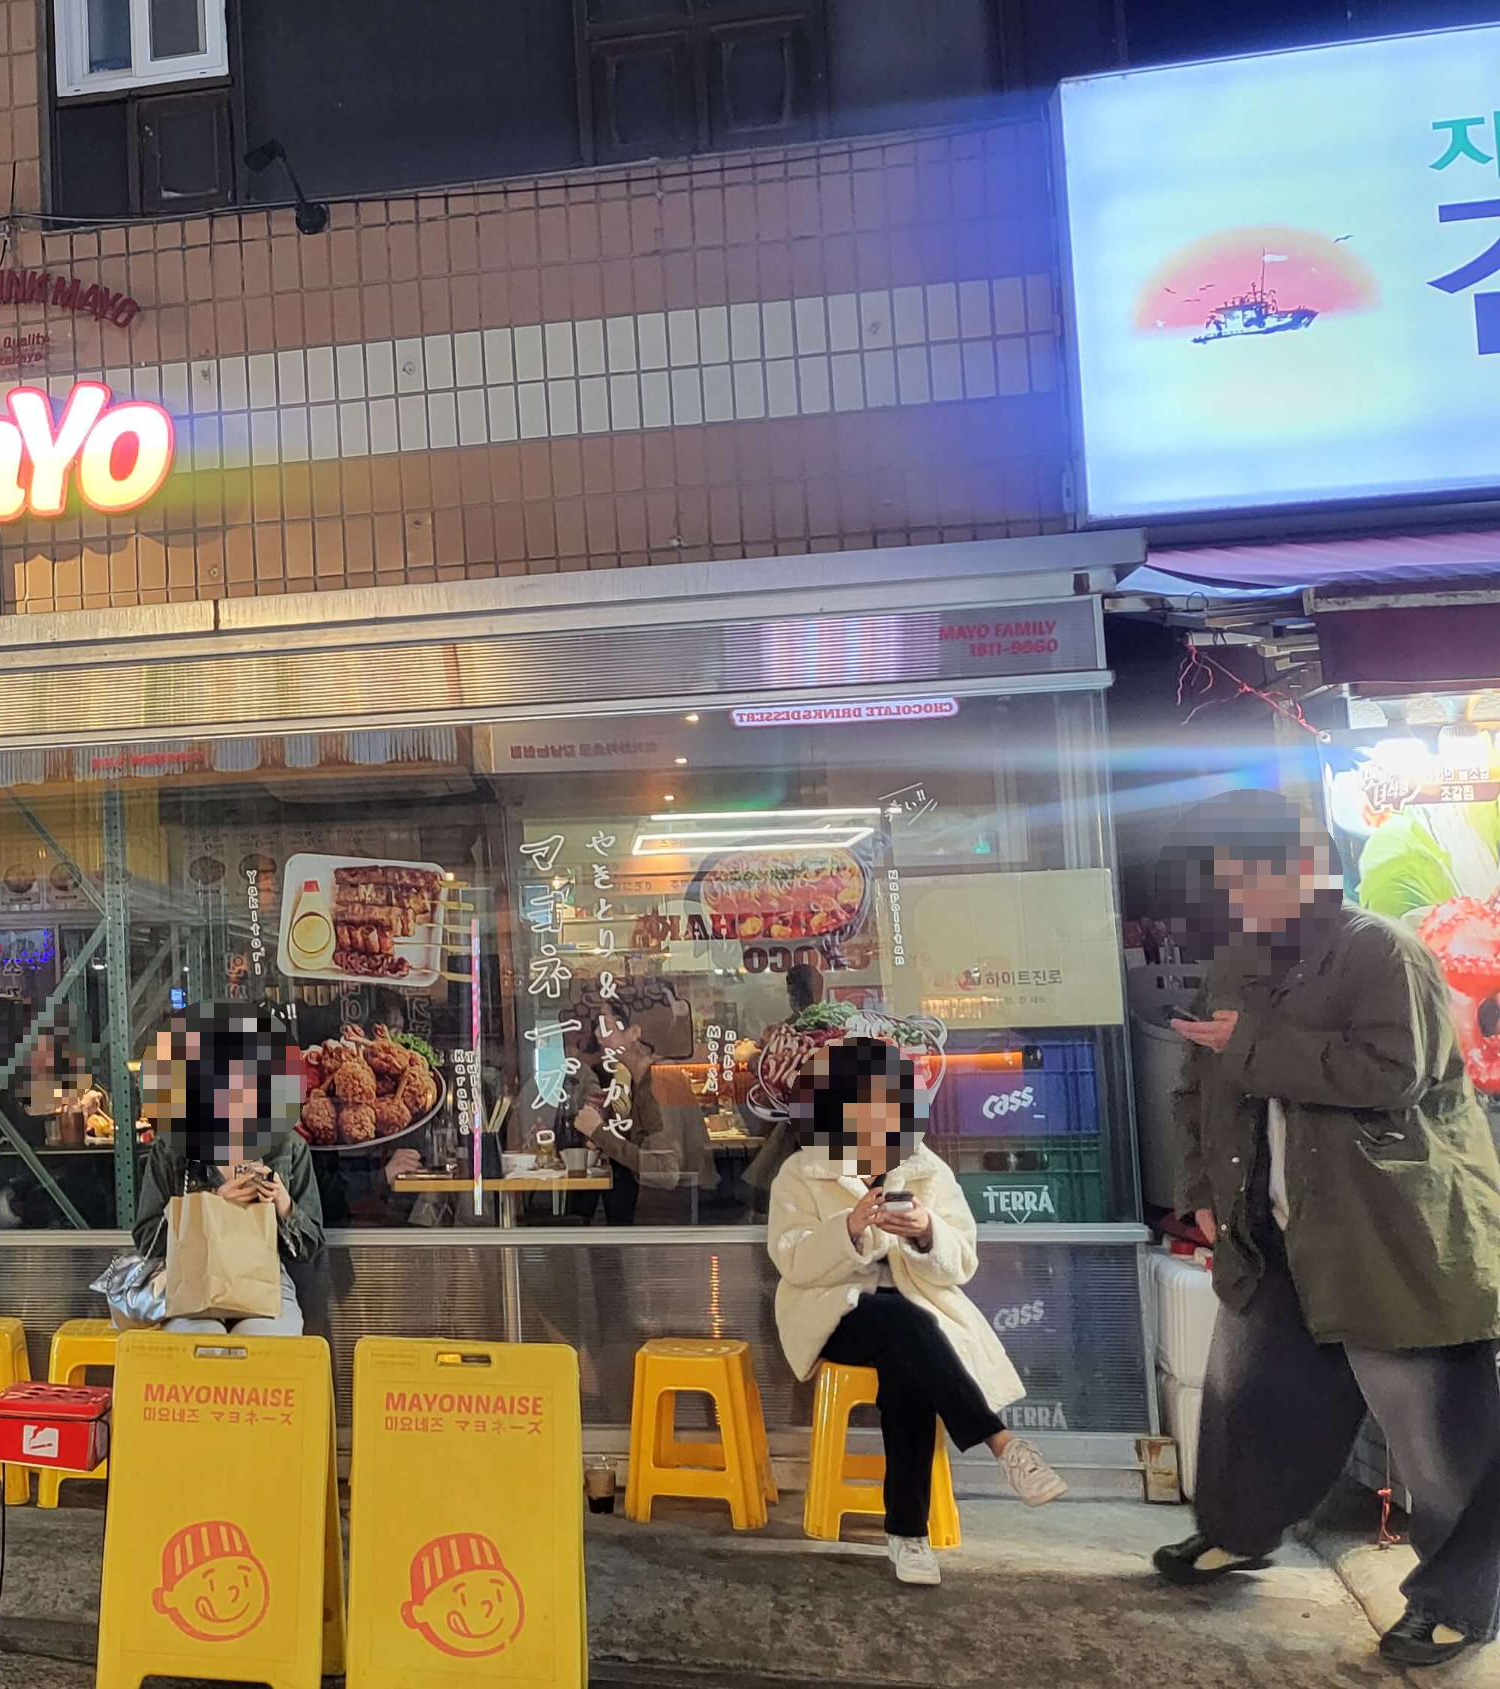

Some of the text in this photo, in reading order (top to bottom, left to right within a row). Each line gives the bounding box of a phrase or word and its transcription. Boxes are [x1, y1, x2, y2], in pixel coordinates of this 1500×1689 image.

[51, 275, 142, 329] MAYO
[3, 332, 50, 349] Quality
[939, 619, 1057, 640] MAYO FAMILY
[246, 870, 263, 976] Yakitori
[985, 969, 1063, 988] 하이트진로
[706, 1025, 737, 1092] Motsu nabe
[454, 1049, 470, 1135] Karaage
[982, 1187, 1055, 1214] TERRA
[144, 1383, 296, 1408] MAYONNAISE
[385, 1391, 545, 1416] MAYONNAISE
[143, 1406, 294, 1426] 마요네즈 マヨネーズ
[384, 1416, 543, 1435] 마요네즈 マヨネーズ
